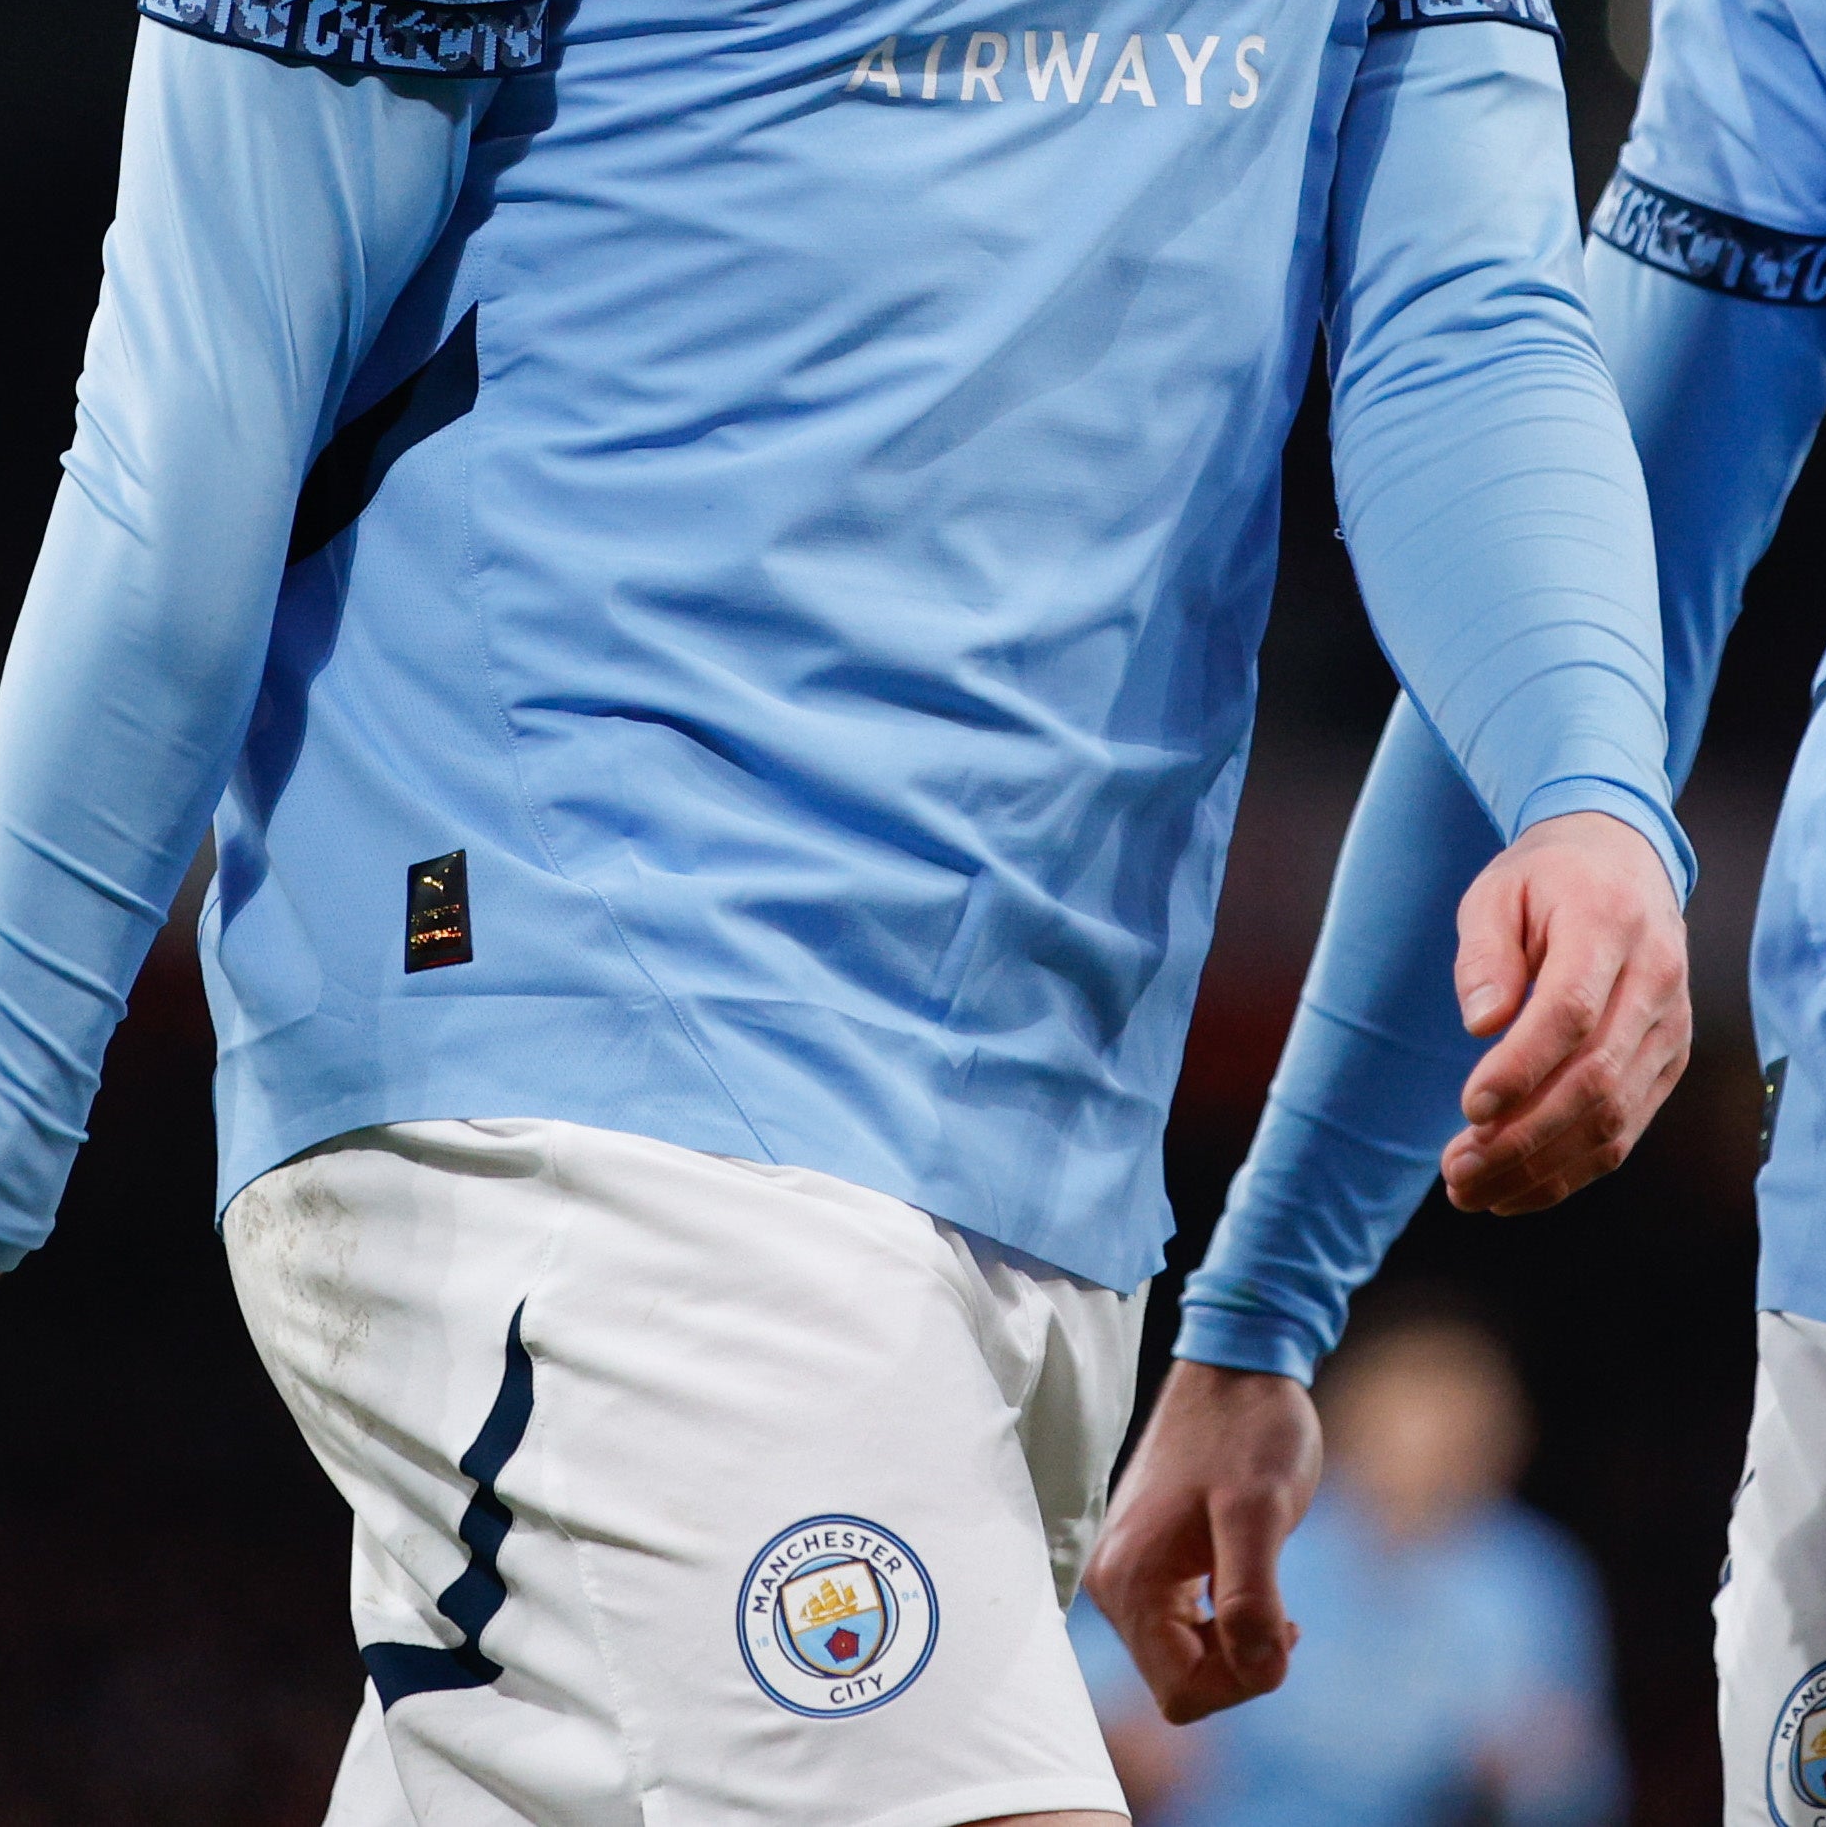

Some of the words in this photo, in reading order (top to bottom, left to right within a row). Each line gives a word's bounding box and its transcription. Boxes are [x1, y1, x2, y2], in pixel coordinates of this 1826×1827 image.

[845, 29, 1268, 110] AIRWAYS
[752, 1531, 903, 1614] MANCHESTER
[829, 1673, 884, 1705] CITY
